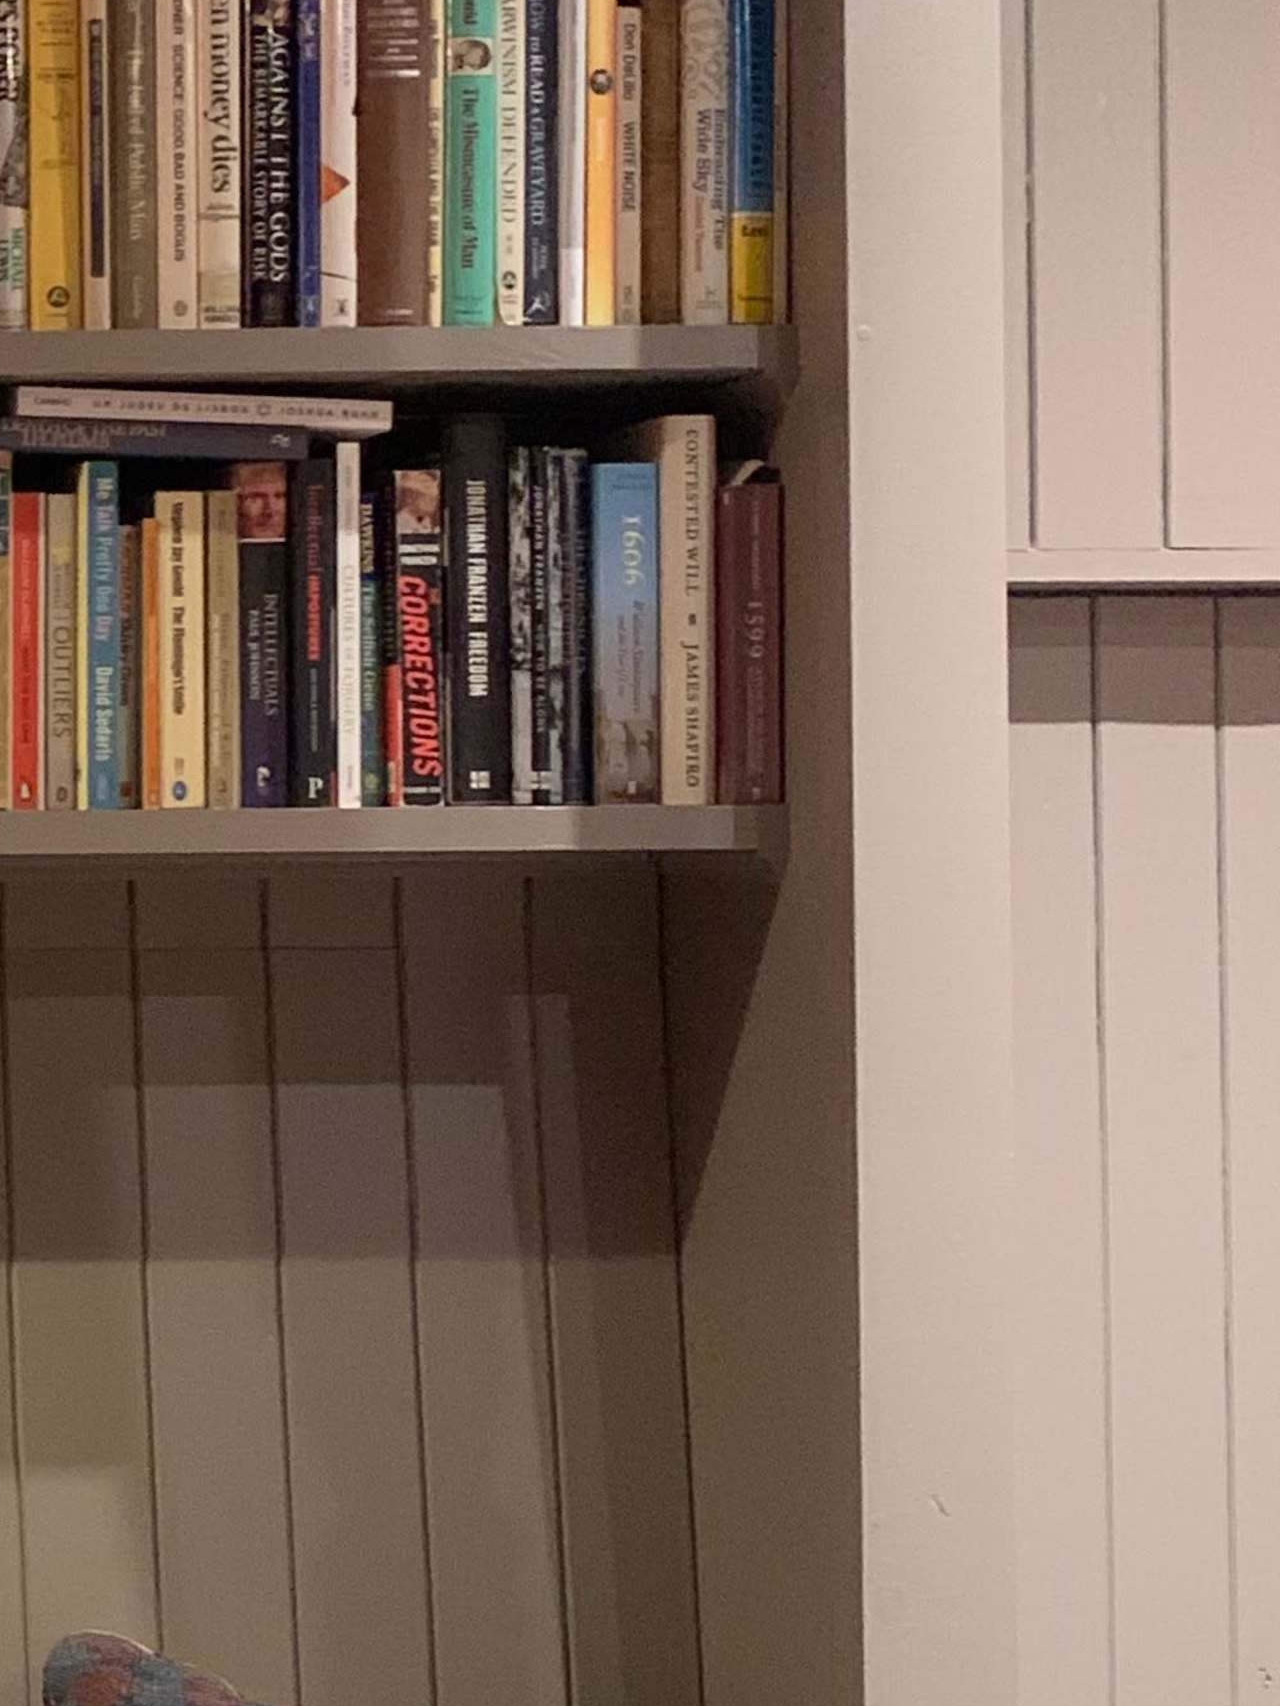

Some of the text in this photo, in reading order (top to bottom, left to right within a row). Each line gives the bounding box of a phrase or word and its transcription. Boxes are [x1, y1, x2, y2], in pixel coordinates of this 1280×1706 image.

[203, 33, 239, 131] money
[622, 23, 637, 214] Don DeLillo WHITE NOISE
[696, 109, 713, 155] Wide
[210, 134, 238, 194] dies
[253, 33, 269, 282] THE REMARKABLE STORY OF RISK
[269, 31, 291, 283] AGAINST THE GODS
[460, 88, 480, 270] The Mismeasure of Man
[502, 104, 520, 223] DEFENDED
[692, 159, 713, 194] Sky
[710, 108, 727, 250] Embracing The
[12, 228, 26, 292] MICHAEL
[306, 485, 325, 662] Intellectual IMPOSTURES
[360, 502, 378, 712] DAWKINS The Selfish Gene
[467, 480, 489, 698] JONATHAN FRANZEN FREEDOM
[620, 515, 646, 587] 1606
[680, 429, 700, 788] CONTESTED WILL JAMES SHAPIRO
[51, 625, 72, 740] OUTLIERS
[93, 476, 115, 762] Me Talk Pretty One Day David Sedaris
[248, 609, 262, 701] PAUL JOHNSON
[264, 593, 280, 718] INTELLECTUALS
[398, 575, 444, 778] CORRECTIONS
[744, 600, 765, 658] 1599
